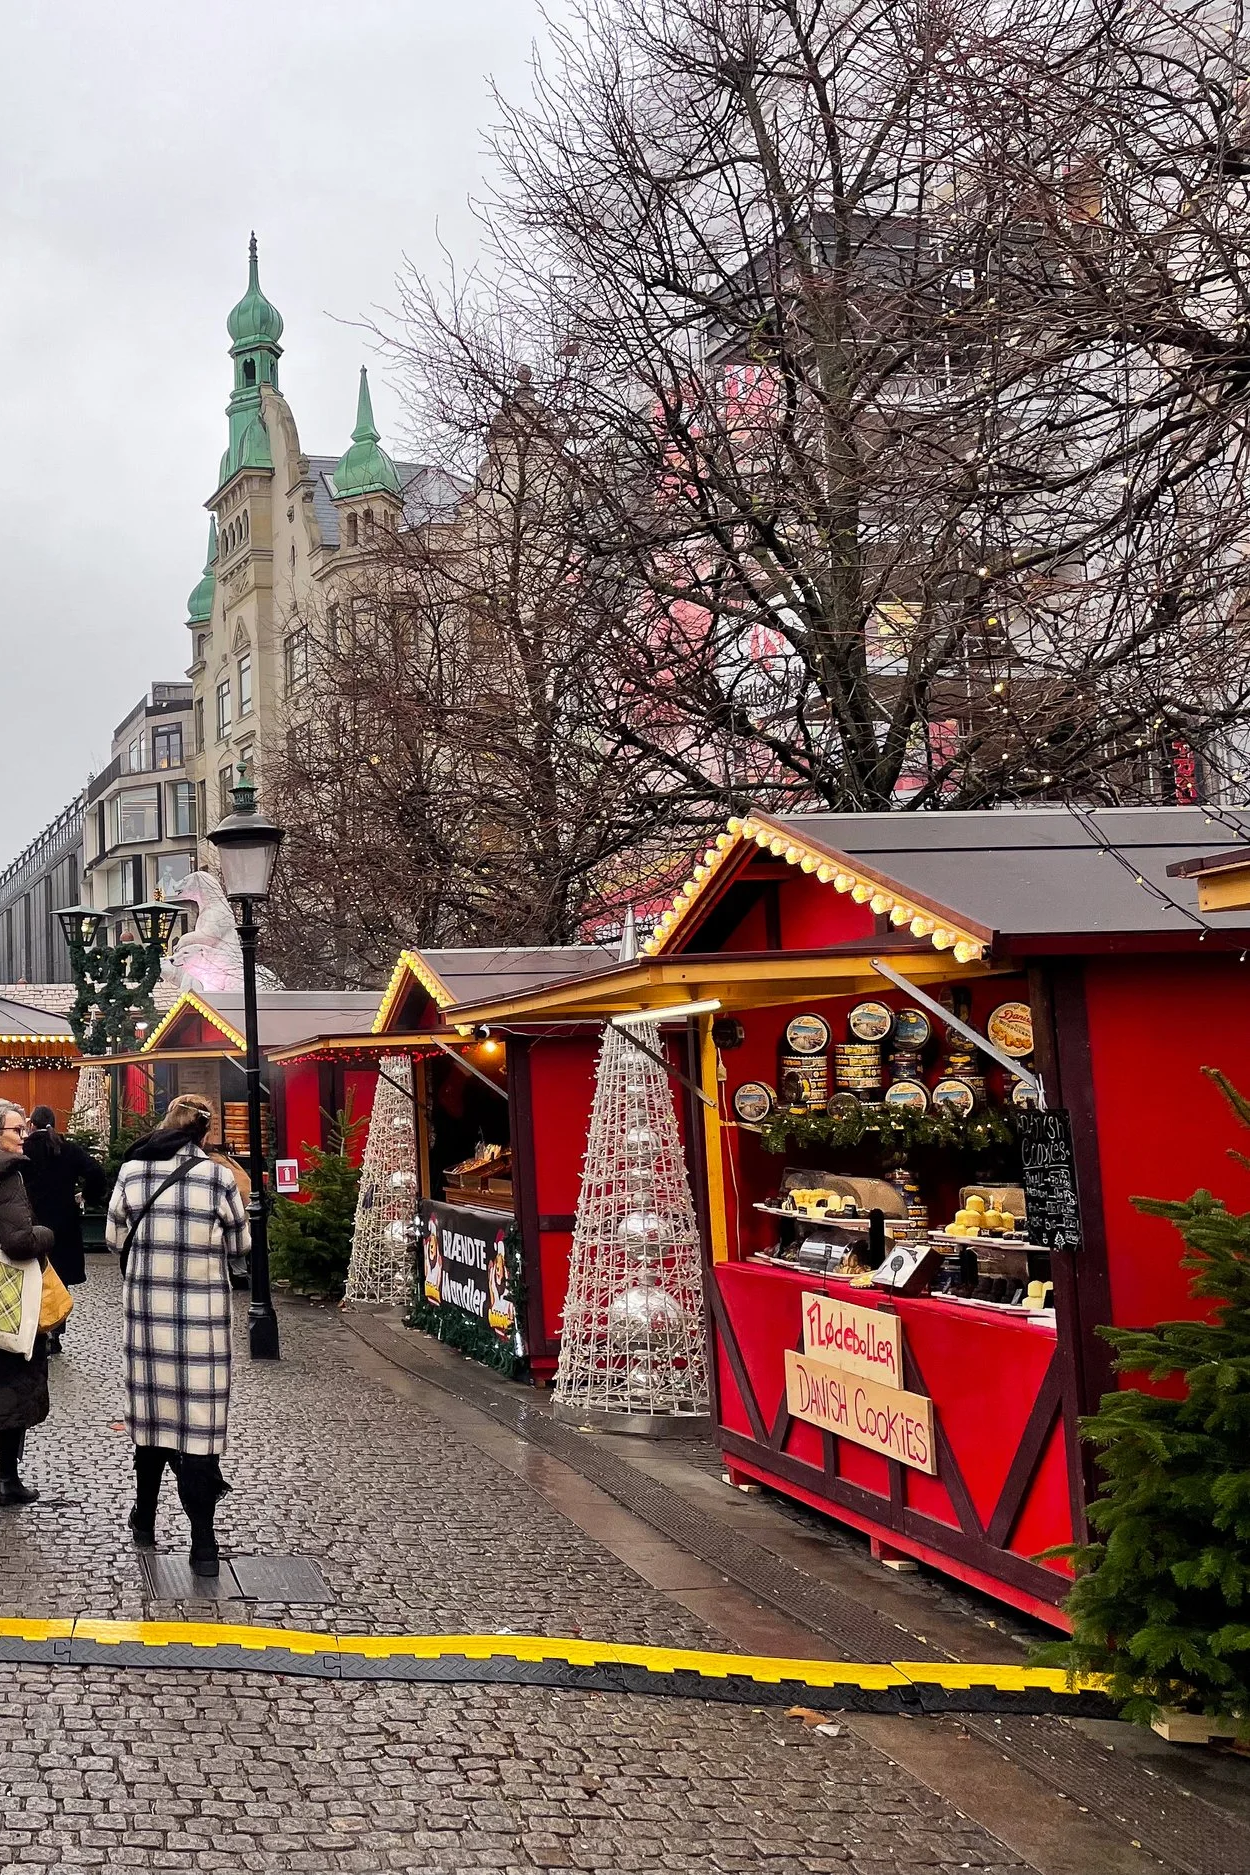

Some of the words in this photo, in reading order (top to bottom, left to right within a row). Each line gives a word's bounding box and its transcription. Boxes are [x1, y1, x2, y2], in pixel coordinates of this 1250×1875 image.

[999, 1009, 1032, 1024] Danis
[442, 1229, 487, 1271] BRÆNDTE
[442, 1270, 487, 1318] Mandler
